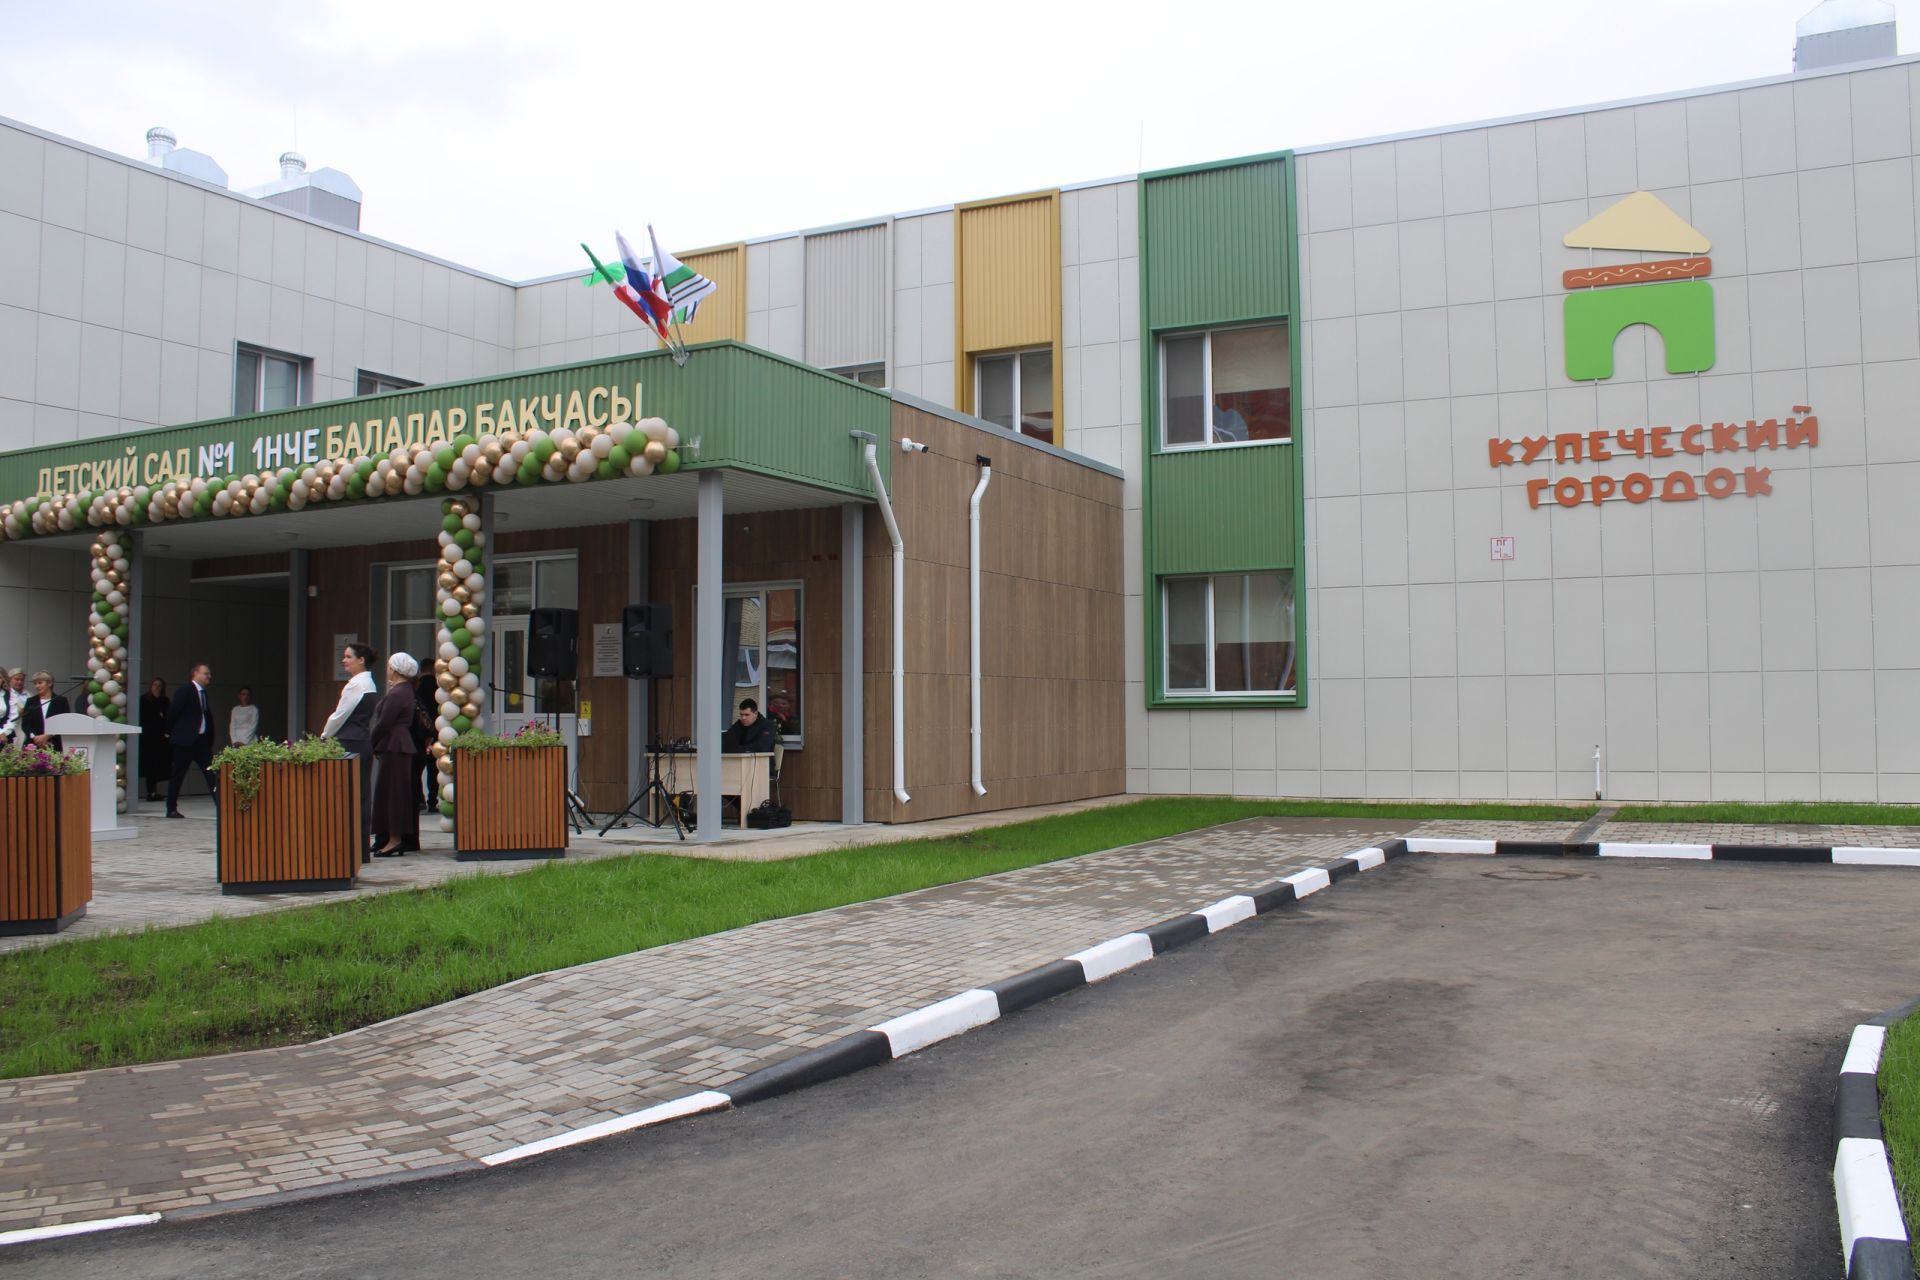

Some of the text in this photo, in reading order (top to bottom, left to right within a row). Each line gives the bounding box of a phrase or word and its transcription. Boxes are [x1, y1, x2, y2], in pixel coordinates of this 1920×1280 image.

[36, 382, 643, 498] ДЕТСКИЙ САД №1 1НЧЕ БАЛАЛАР БАКЧАСЫ
[1488, 405, 1819, 467] КУПЕЧЕСКИЙ
[1526, 466, 1774, 510] ГОРОДОК
